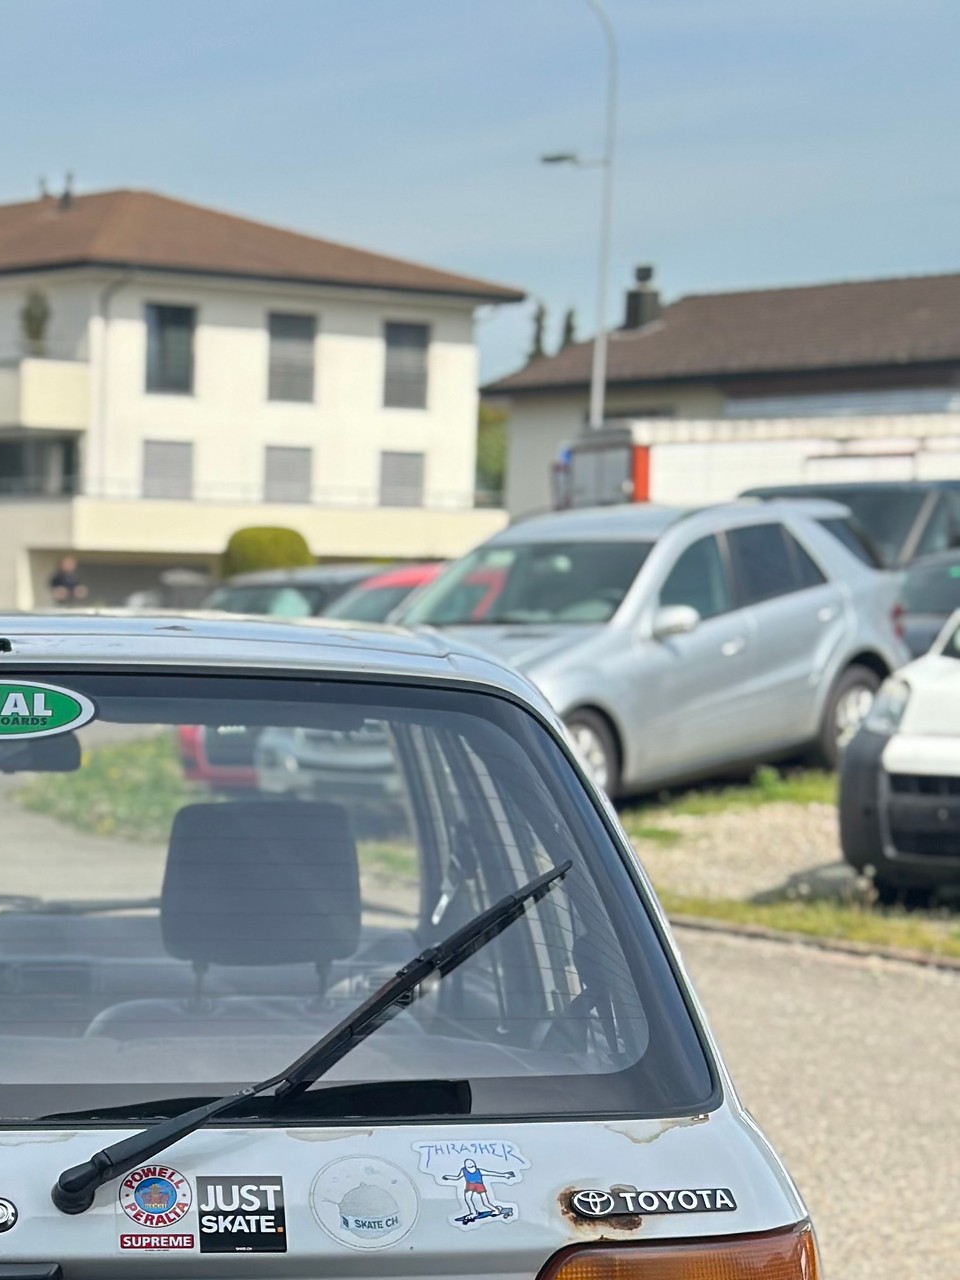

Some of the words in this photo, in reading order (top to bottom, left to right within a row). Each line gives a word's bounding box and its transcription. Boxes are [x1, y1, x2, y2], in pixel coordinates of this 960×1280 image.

[419, 1143, 525, 1168] THRASHER
[123, 1166, 185, 1190] POWELL
[200, 1184, 281, 1212] JUST
[619, 1189, 734, 1212] TOYOTA
[124, 1202, 189, 1226] PERALTA
[201, 1215, 284, 1234] SKATE.
[354, 1218, 384, 1229] SKATE
[385, 1215, 399, 1228] CH
[123, 1236, 192, 1247] SUPREME
